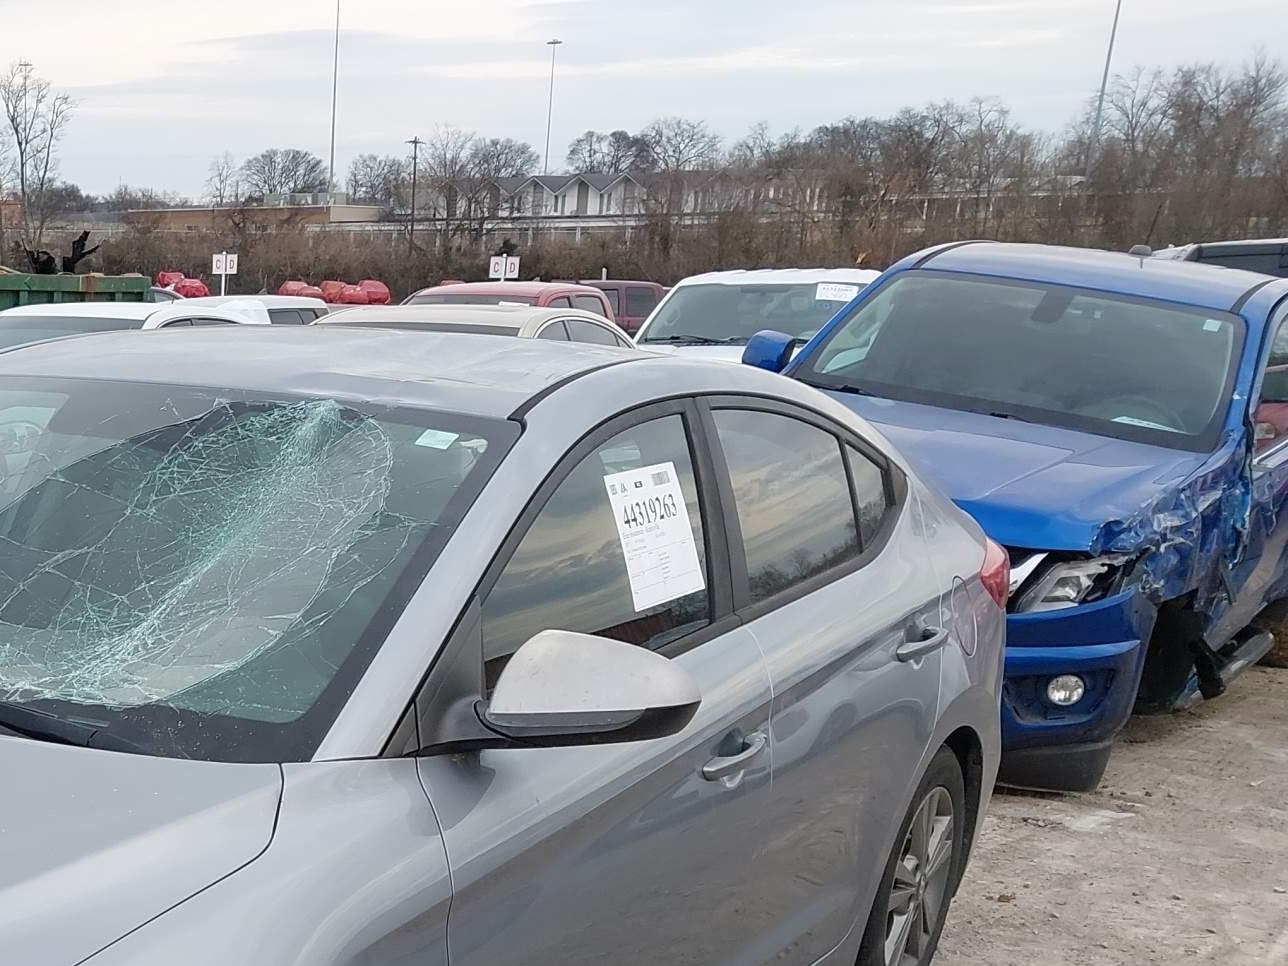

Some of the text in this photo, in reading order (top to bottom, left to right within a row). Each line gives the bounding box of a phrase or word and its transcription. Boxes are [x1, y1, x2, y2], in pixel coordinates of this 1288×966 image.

[215, 259, 235, 270] C D
[493, 262, 516, 273] C D
[623, 493, 678, 529] 44319263
